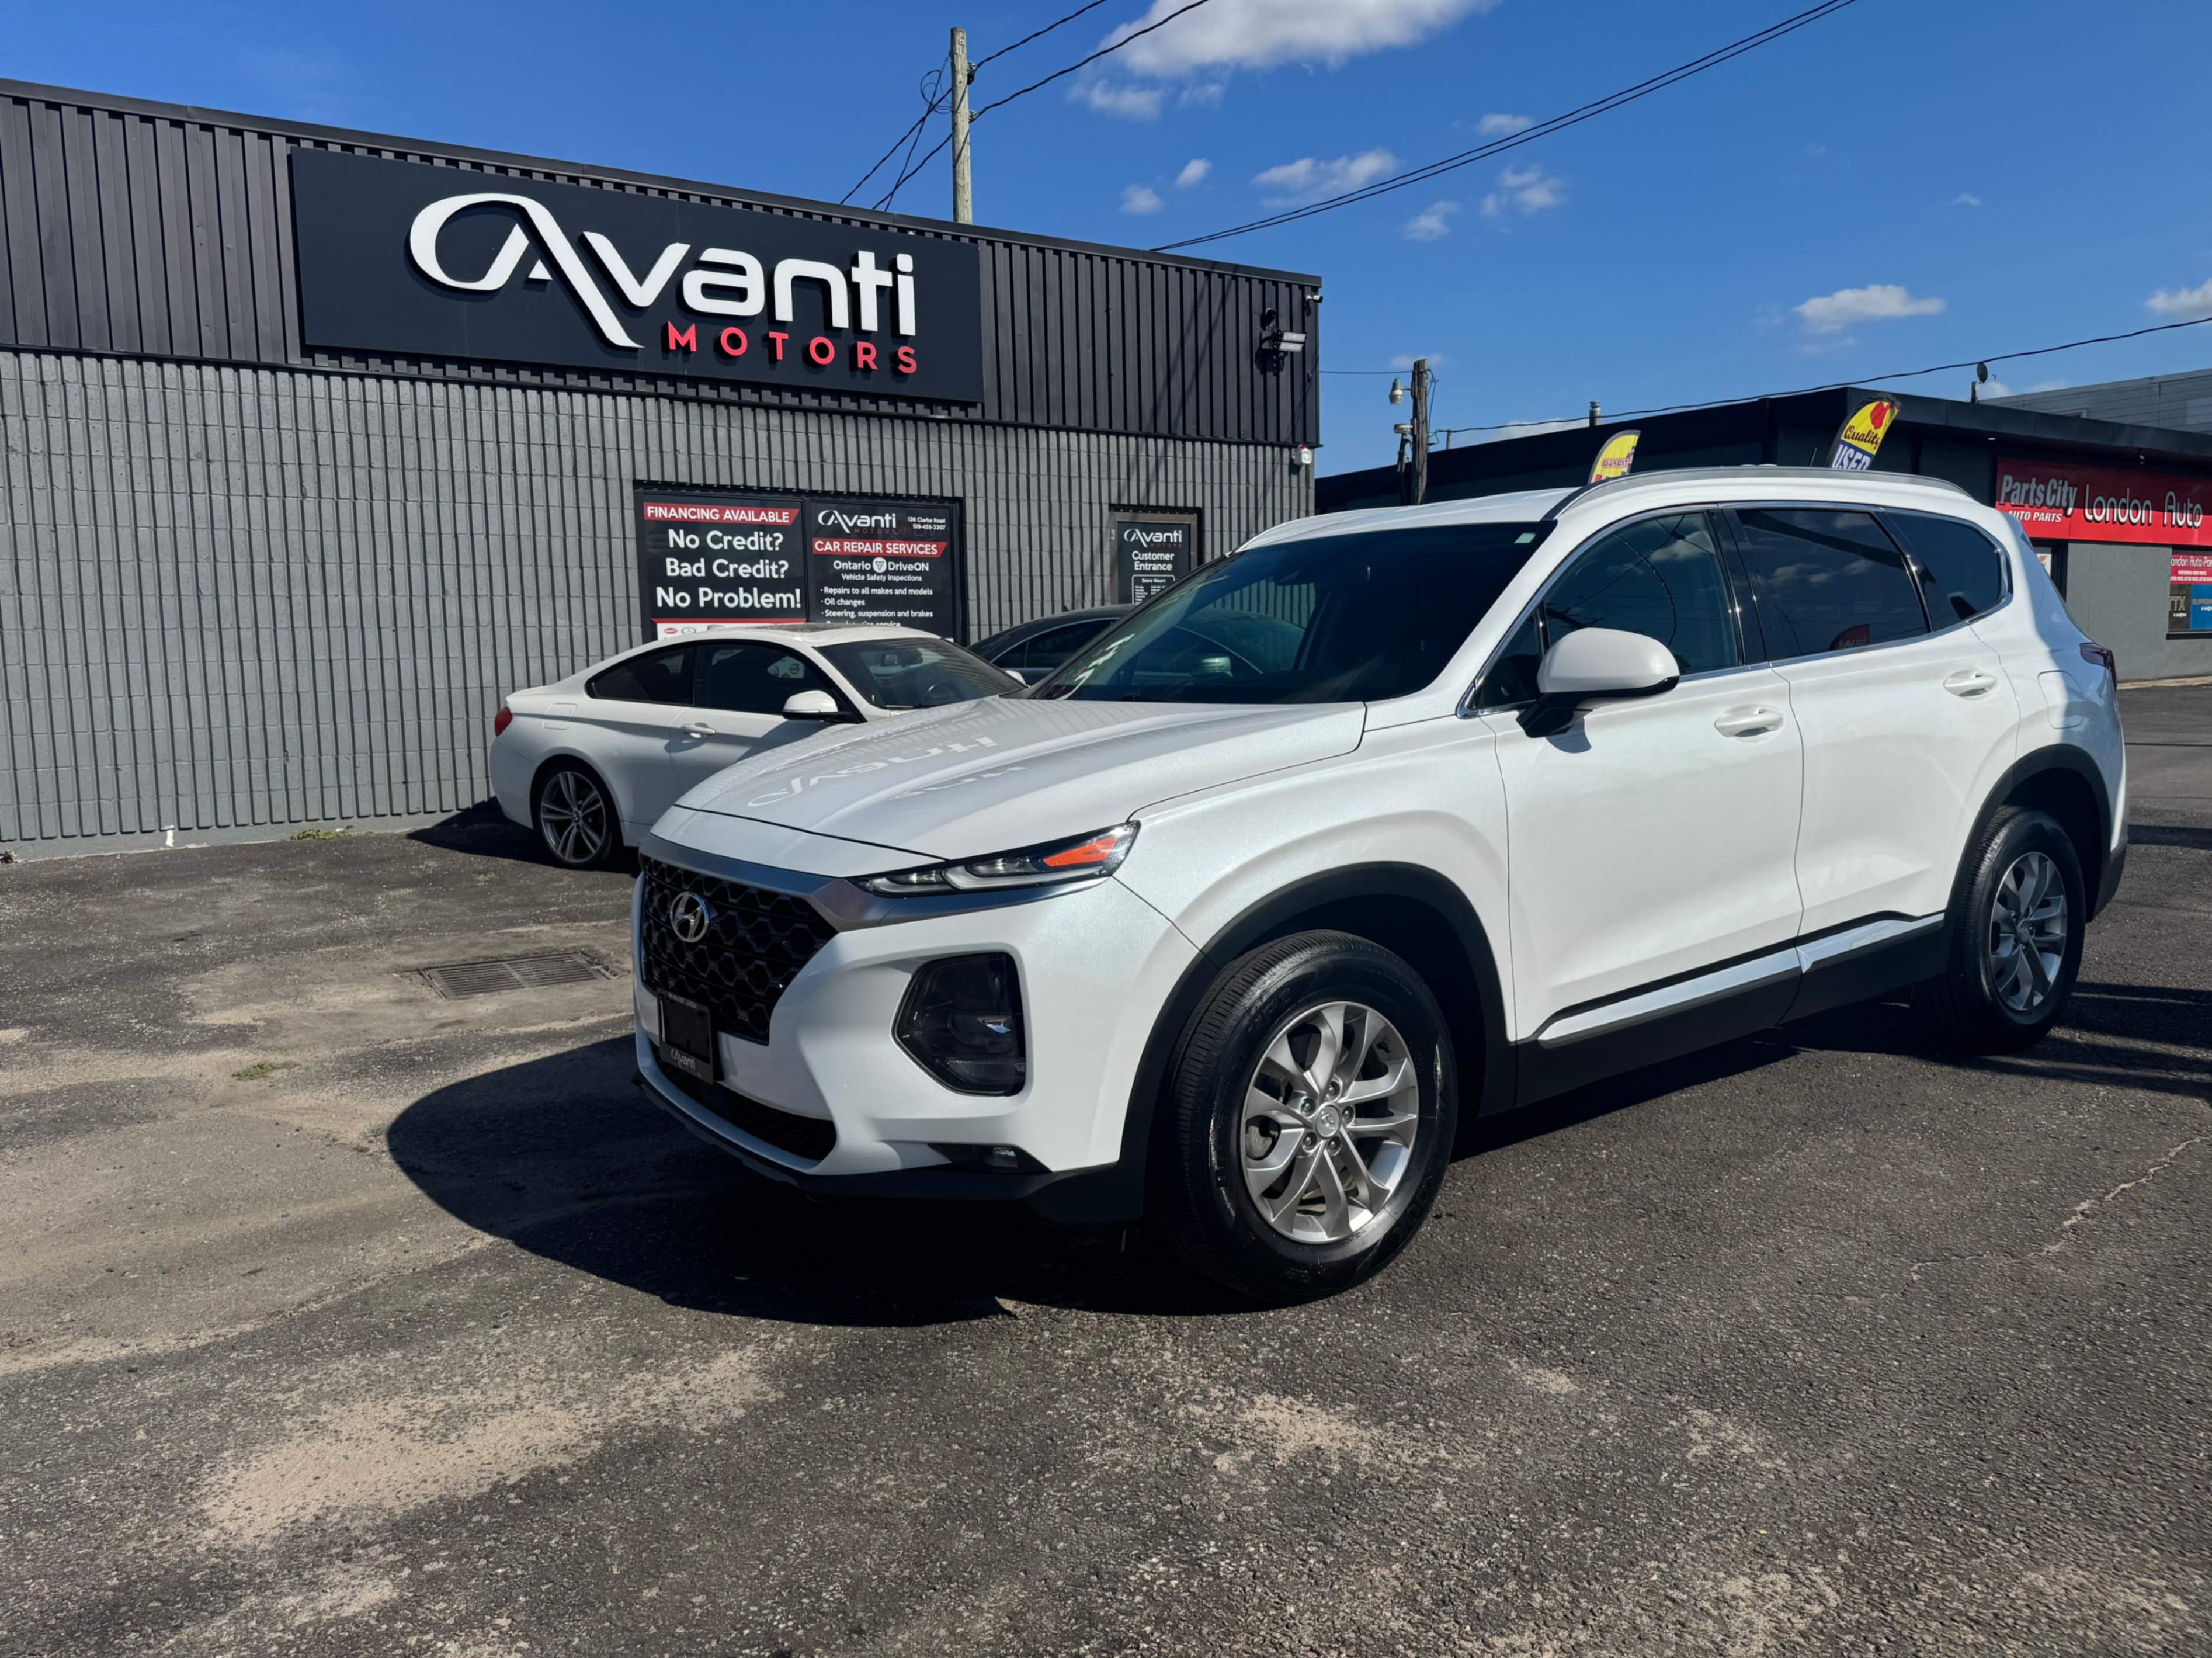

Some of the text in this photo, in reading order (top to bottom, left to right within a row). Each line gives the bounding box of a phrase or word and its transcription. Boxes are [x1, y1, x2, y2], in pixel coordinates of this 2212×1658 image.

[410, 193, 916, 349] Avanti
[667, 320, 918, 374] MOTORS
[1843, 425, 1879, 450] Quality
[1602, 458, 1631, 468] QUALIT
[2084, 484, 2203, 528] London Auto
[647, 506, 790, 523] FINANCING AVAILABLE
[818, 510, 896, 533] Avanti
[2033, 512, 2062, 523] PARTS
[668, 529, 783, 551] No Credit?
[1124, 529, 1182, 547] Avanti
[814, 541, 938, 555] CAR REPAIR SERVICES
[1132, 550, 1175, 560] Customer
[666, 557, 789, 578] Bad Credit?
[833, 560, 929, 572] Ontario DriveON
[1134, 561, 1173, 571] Entrance
[2171, 556, 2189, 567] ondon
[2190, 556, 2203, 567] Auto
[866, 573, 886, 582] Safety
[887, 574, 922, 582] Inspections
[656, 587, 801, 608] No Problem!
[824, 586, 850, 595] Repairs
[860, 587, 870, 595] all
[836, 598, 866, 608] changes
[825, 609, 856, 619] Steering,
[857, 609, 895, 619] suspension
[911, 609, 933, 618] brakes
